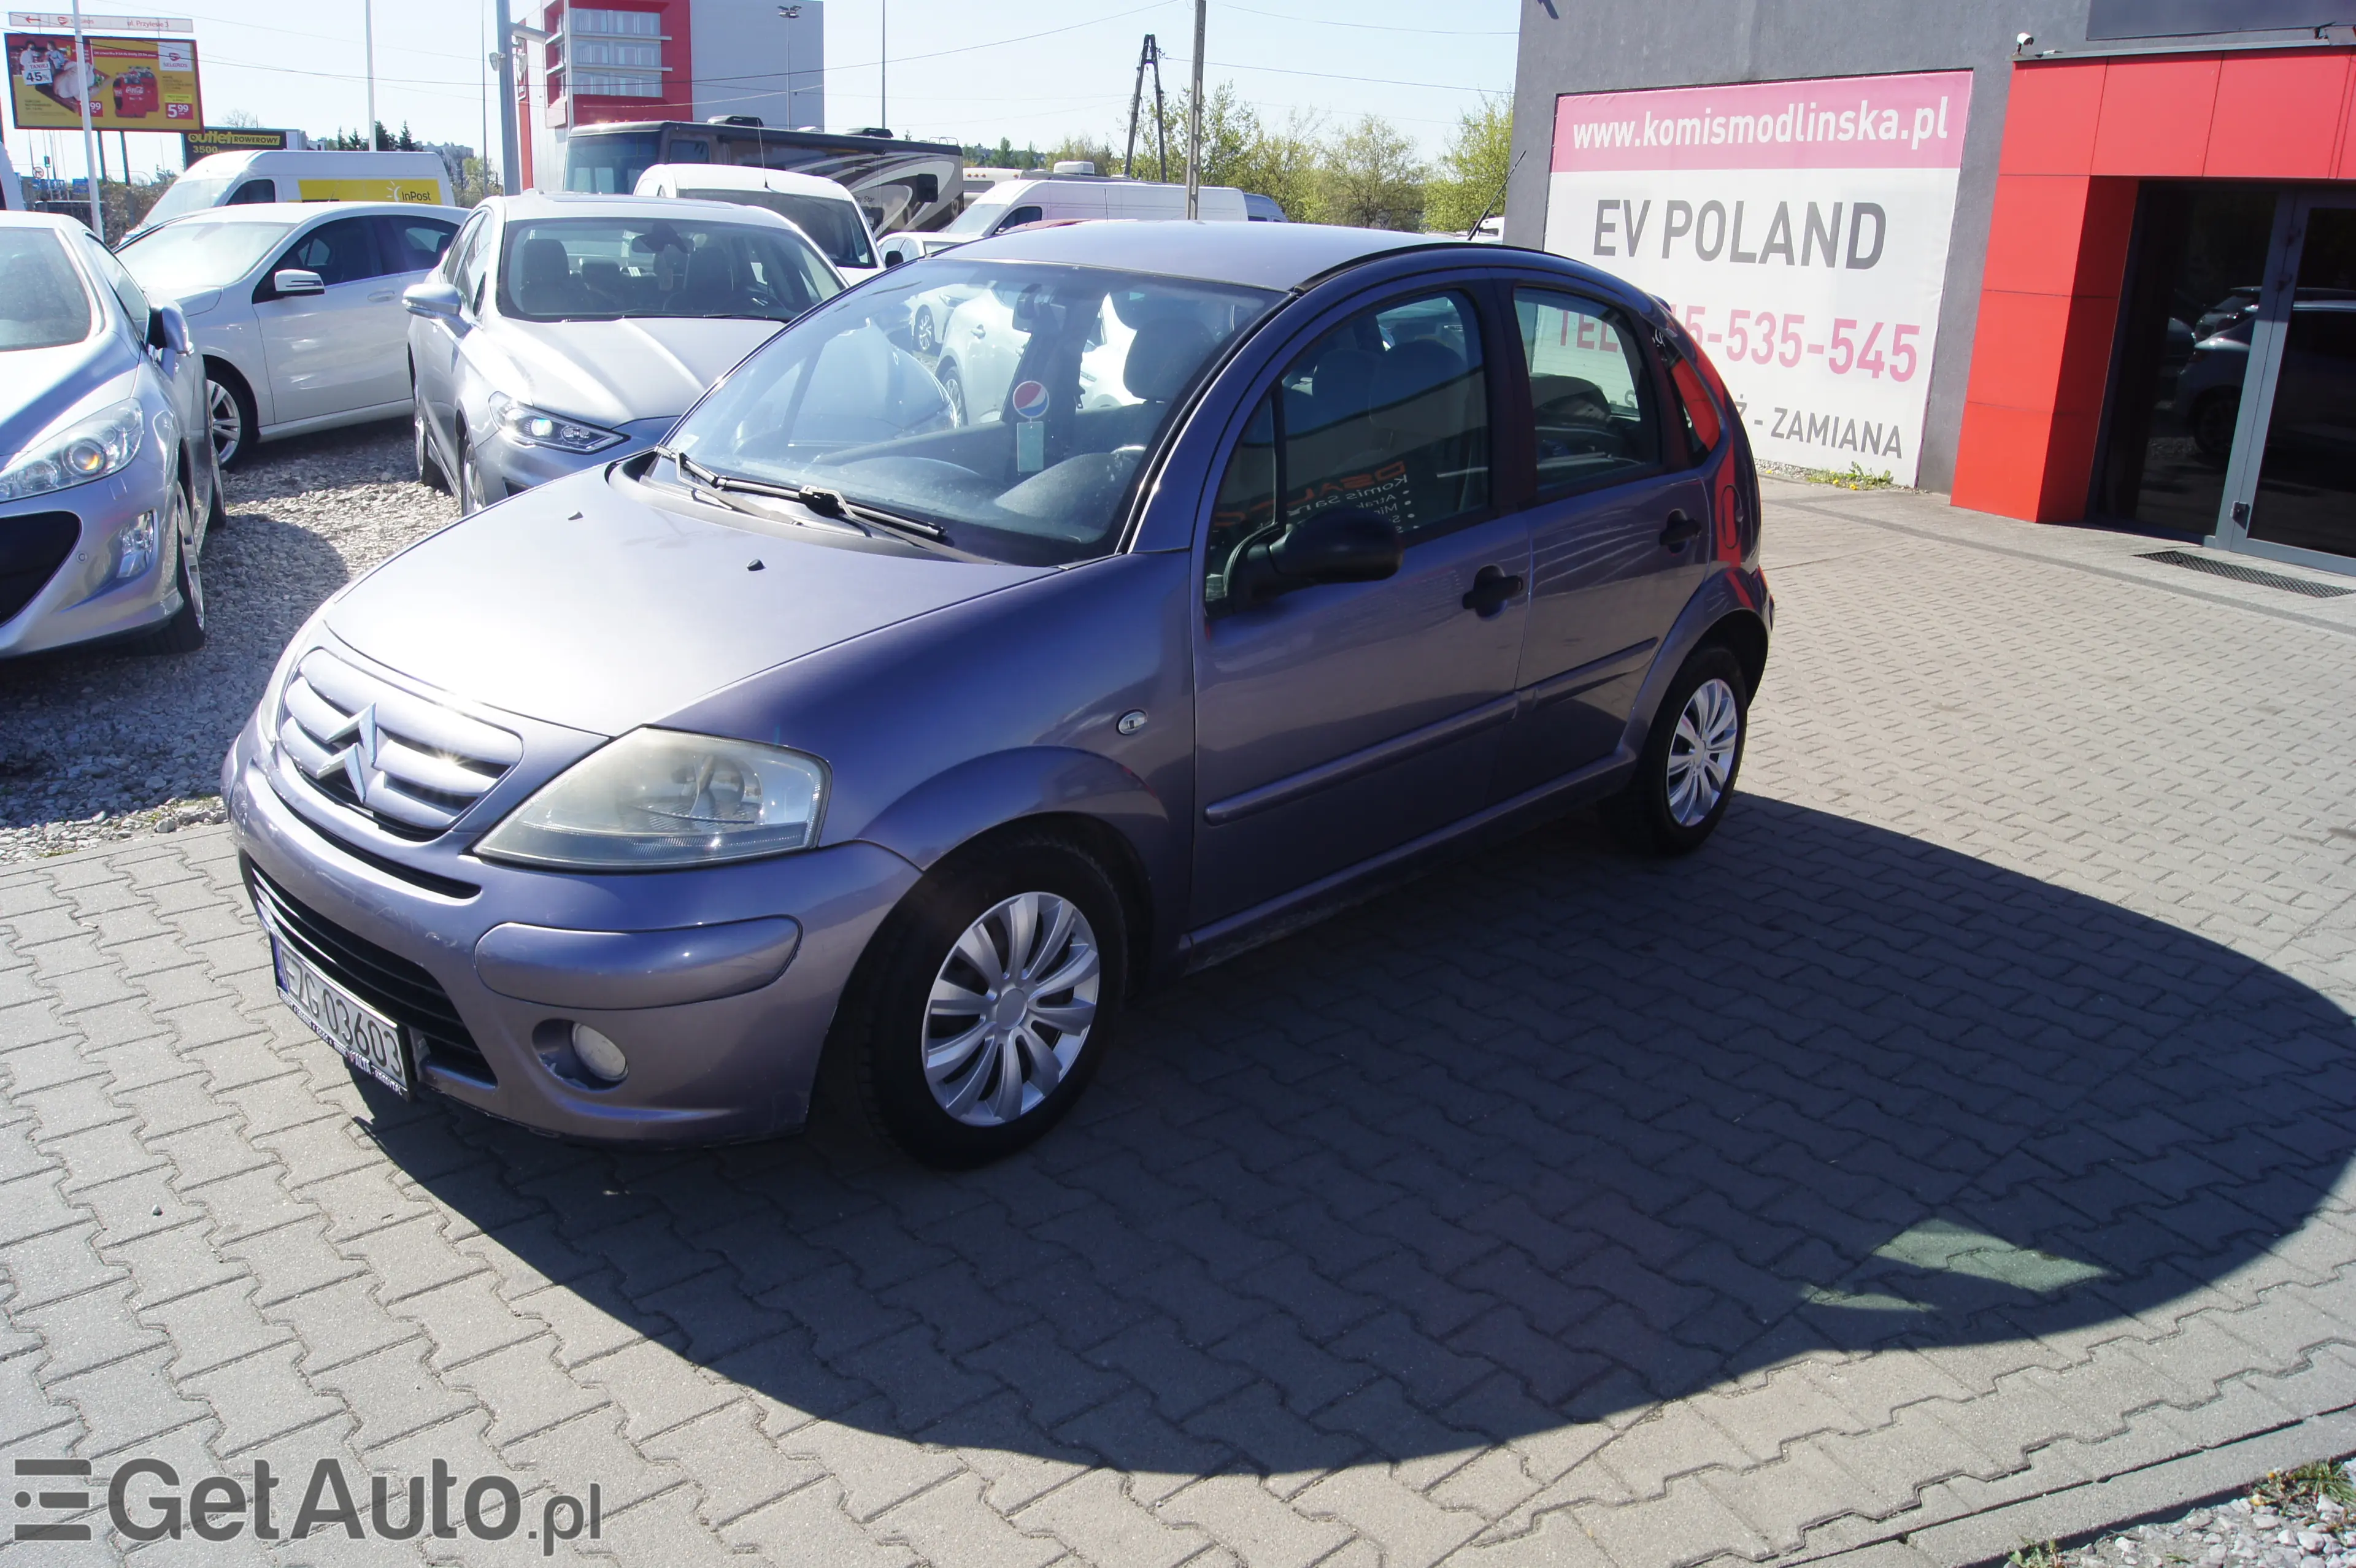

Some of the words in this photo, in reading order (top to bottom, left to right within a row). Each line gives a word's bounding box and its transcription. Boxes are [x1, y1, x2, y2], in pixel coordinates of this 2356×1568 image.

[26, 71, 50, 82] 45%
[188, 131, 232, 144] outlet
[234, 136, 278, 144] ROWEROWY
[1573, 96, 1949, 150] www.komismodlinska.pl
[193, 145, 218, 154] 3500
[401, 191, 431, 202] InPost
[1593, 199, 1652, 258] EV
[1661, 199, 1887, 271] POLAND
[1771, 407, 1903, 459] ZAMIANA
[280, 948, 320, 1019] EZG
[323, 988, 403, 1078] 03603
